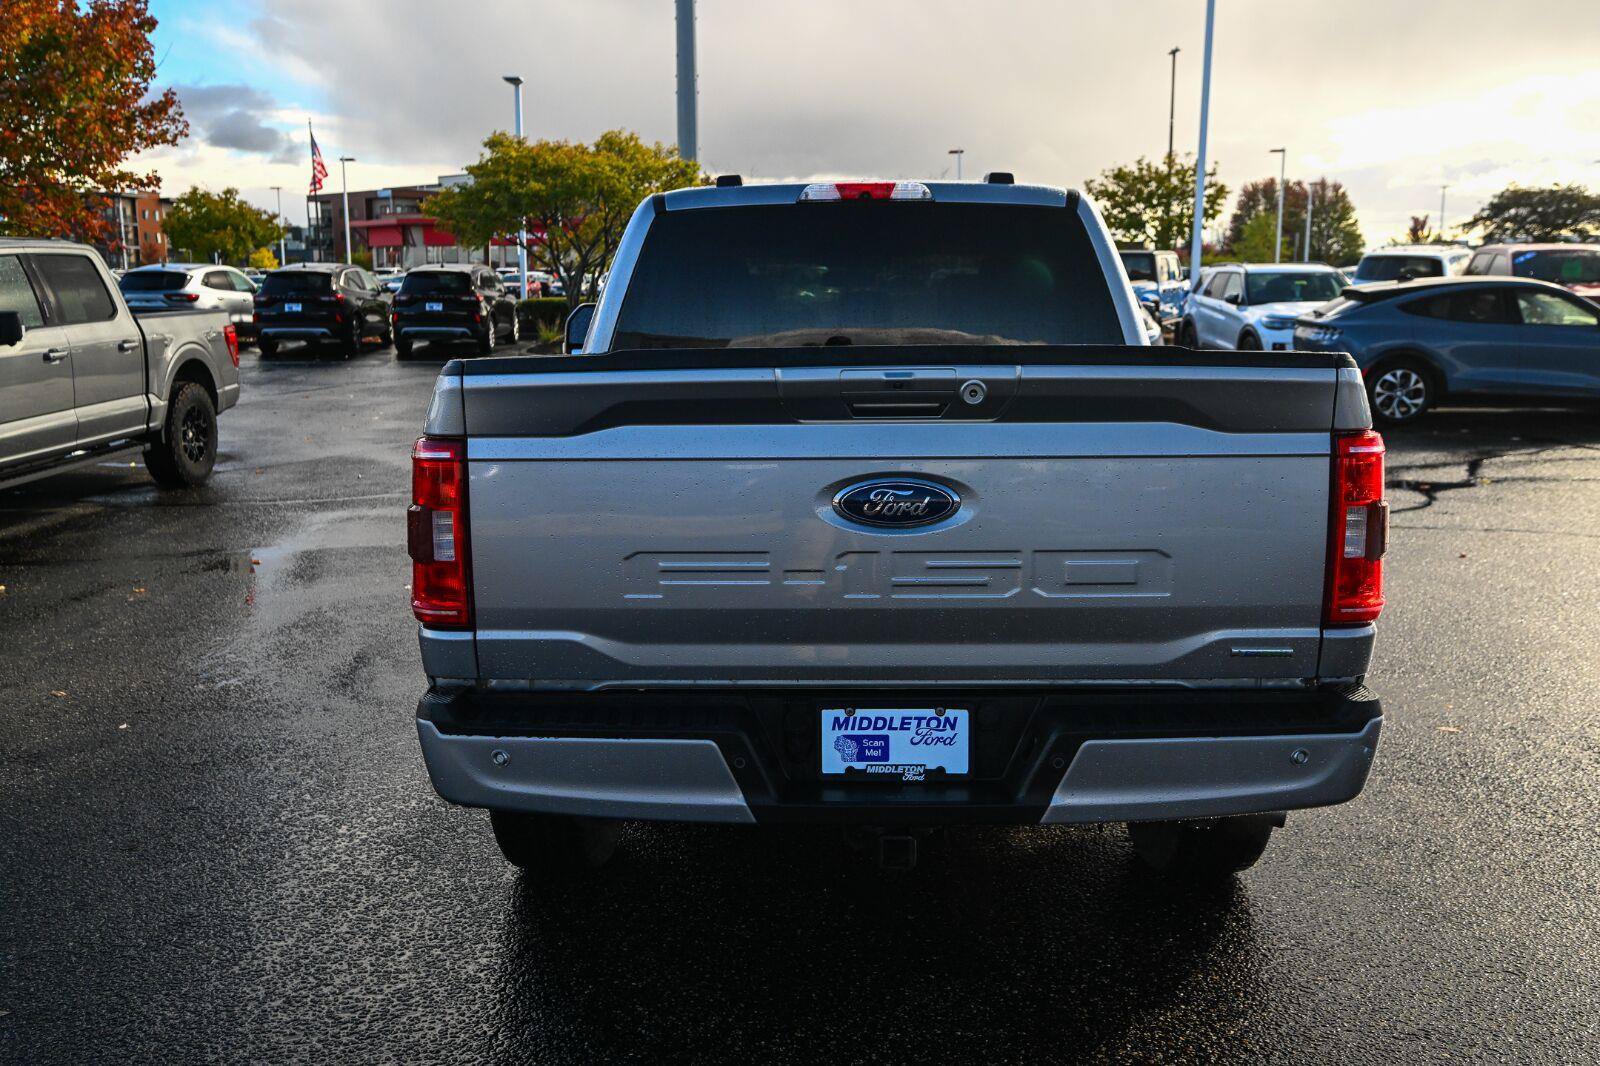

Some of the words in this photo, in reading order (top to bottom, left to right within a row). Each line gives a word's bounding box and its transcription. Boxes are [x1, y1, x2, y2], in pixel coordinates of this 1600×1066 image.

[863, 488, 931, 515] Ford
[622, 549, 1172, 599] F-150
[832, 716, 958, 731] MIDDLETON
[909, 727, 958, 746] Ford
[862, 739, 884, 747] Scan
[865, 749, 882, 757] Me!
[867, 765, 925, 774] MIDDLETON
[902, 771, 925, 781] Ford
